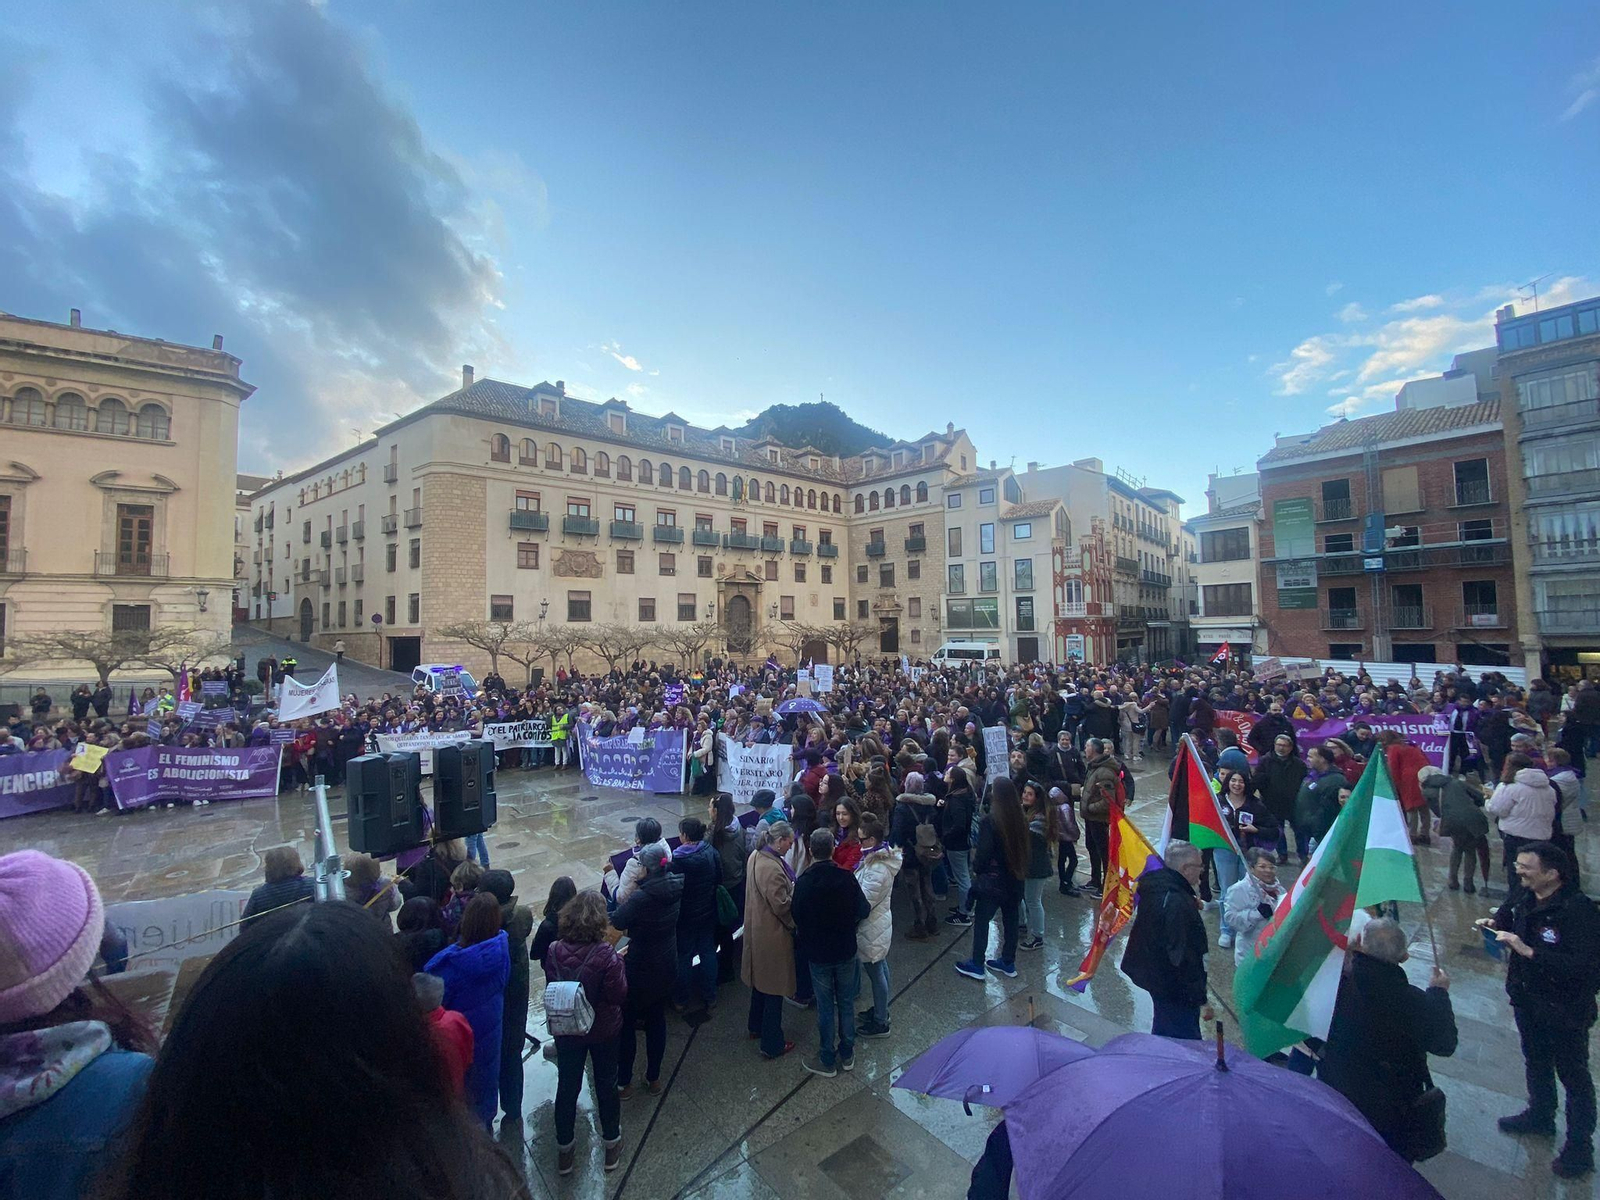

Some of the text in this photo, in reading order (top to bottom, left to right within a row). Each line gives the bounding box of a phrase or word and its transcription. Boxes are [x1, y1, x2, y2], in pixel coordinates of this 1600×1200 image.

[159, 753, 240, 767] EL FEMINISMO
[147, 768, 159, 780] ES
[162, 767, 250, 780] ABOLICIONISTA
